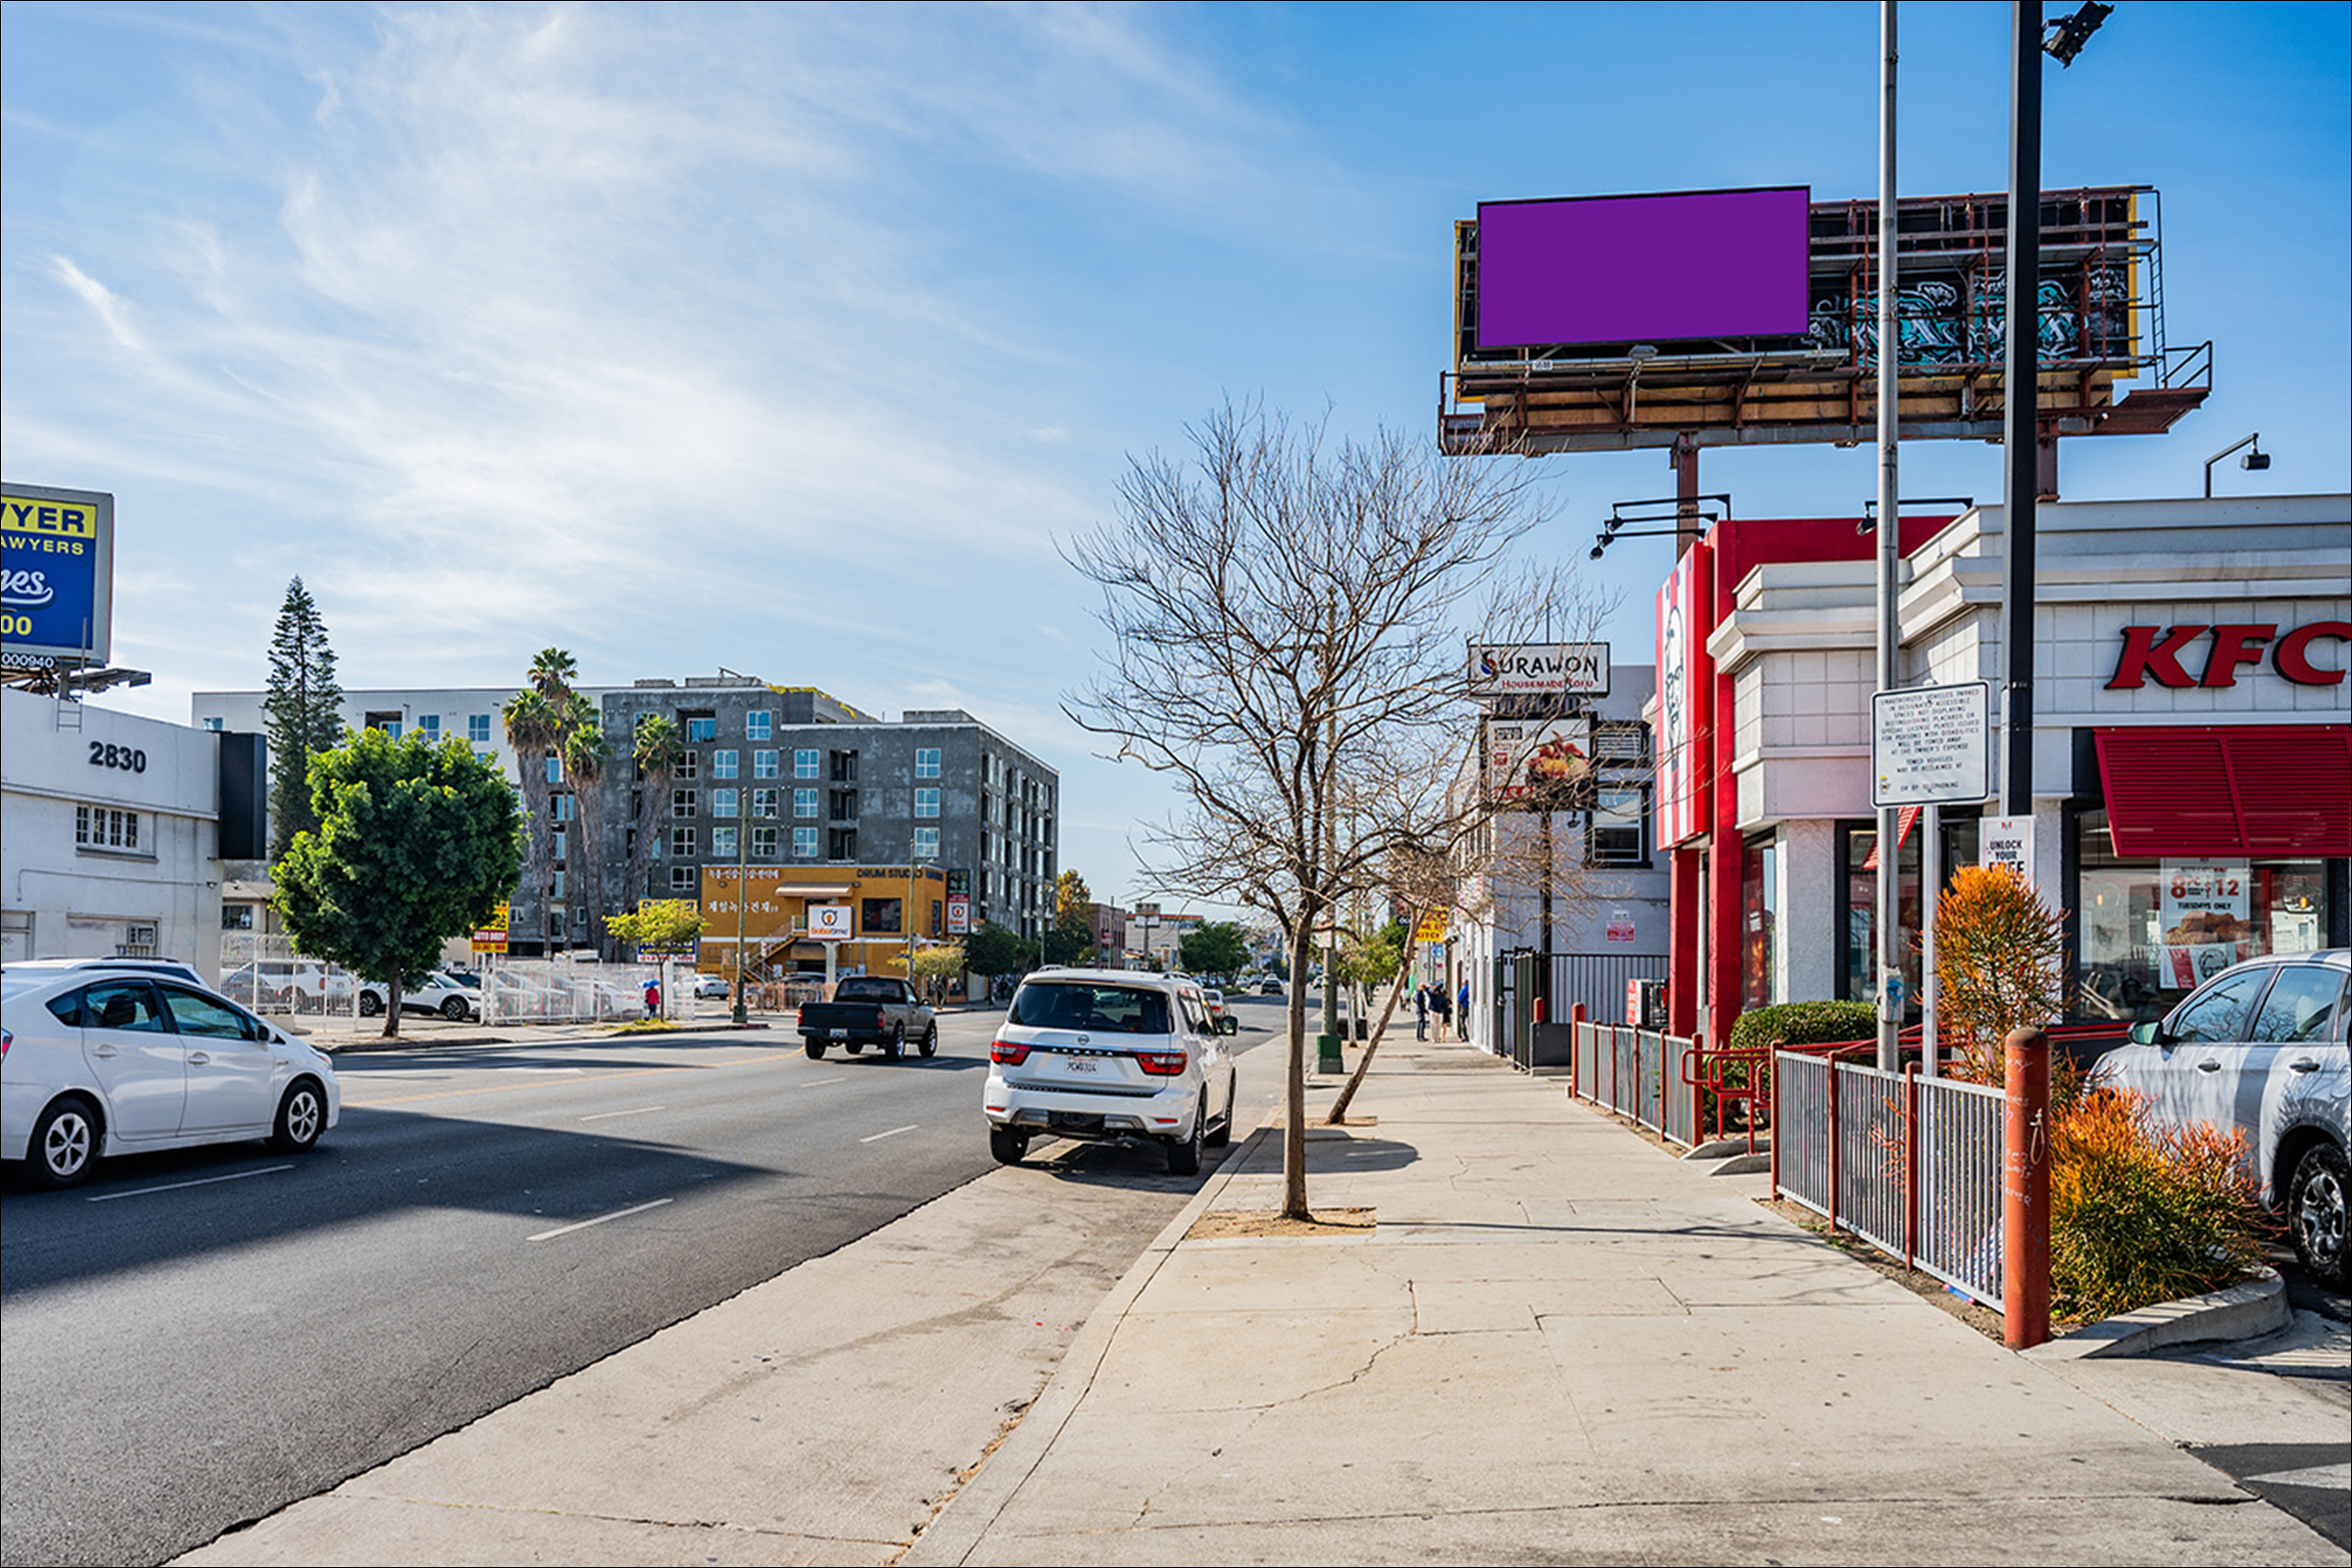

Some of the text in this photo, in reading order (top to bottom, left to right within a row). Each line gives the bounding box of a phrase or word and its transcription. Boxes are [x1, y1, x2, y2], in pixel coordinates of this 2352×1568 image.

[1, 503, 84, 533] YER
[1481, 650, 1598, 682] SURAWON
[2104, 621, 2350, 689] KFC
[89, 741, 147, 773] 2830
[1989, 840, 2022, 850] UNLOCK
[857, 869, 886, 878] DRUM
[888, 869, 923, 878] STUDO
[2171, 874, 2186, 899] 8
